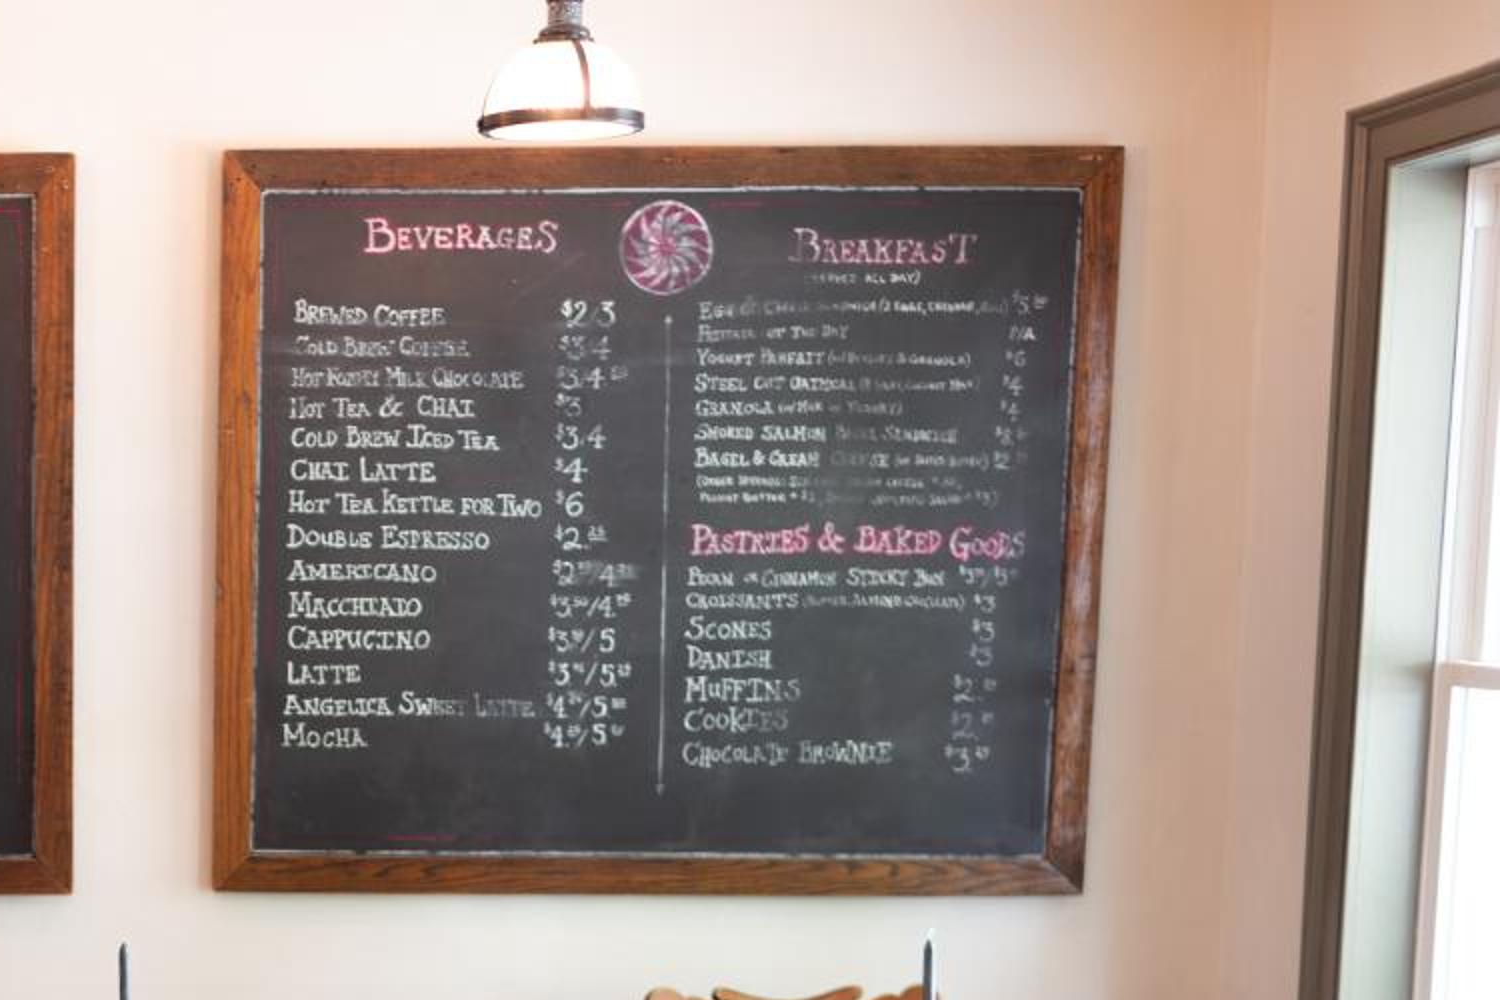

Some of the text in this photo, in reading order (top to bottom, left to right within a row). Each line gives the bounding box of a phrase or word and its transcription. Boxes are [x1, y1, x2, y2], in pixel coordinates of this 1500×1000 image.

[364, 217, 559, 254] BEVERAGES
[788, 227, 977, 265] BREAKFAST
[294, 299, 447, 327] BREWED COFFEE
[434, 370, 525, 389] CHOCOLATE
[694, 373, 748, 392] STEEL
[289, 394, 476, 418] HOT TEA & CHAI
[291, 423, 501, 451] COLD BREW ICED TEA
[694, 424, 753, 441] SMOKED
[760, 426, 826, 442] SALMON
[291, 457, 436, 483] CHAI LATTE
[553, 457, 588, 483] $4
[694, 447, 820, 467] BAGEL & CREAM
[288, 488, 542, 518] HOT TEA KETTLE FOR TWO
[554, 489, 585, 517] $6
[287, 523, 490, 550] DOUBLE ESPRESSO
[690, 522, 1026, 561] PASTRIES & BAKED GOODS
[287, 560, 437, 584] AMERICANO
[288, 591, 422, 619] MACCHIATO
[686, 593, 799, 609] CROISSANTS
[288, 626, 431, 651] CAPPUCINO
[685, 615, 771, 640] SCONES
[688, 644, 771, 669] DANISH
[287, 660, 362, 686] LATTE
[684, 675, 801, 703] MUFFINS
[283, 694, 394, 716] ANGELICA
[475, 693, 535, 717] LATTE
[684, 707, 788, 733] COOKIES
[281, 723, 368, 748] MOCHA
[682, 740, 894, 768] CHOCOLATE BROWNIE
